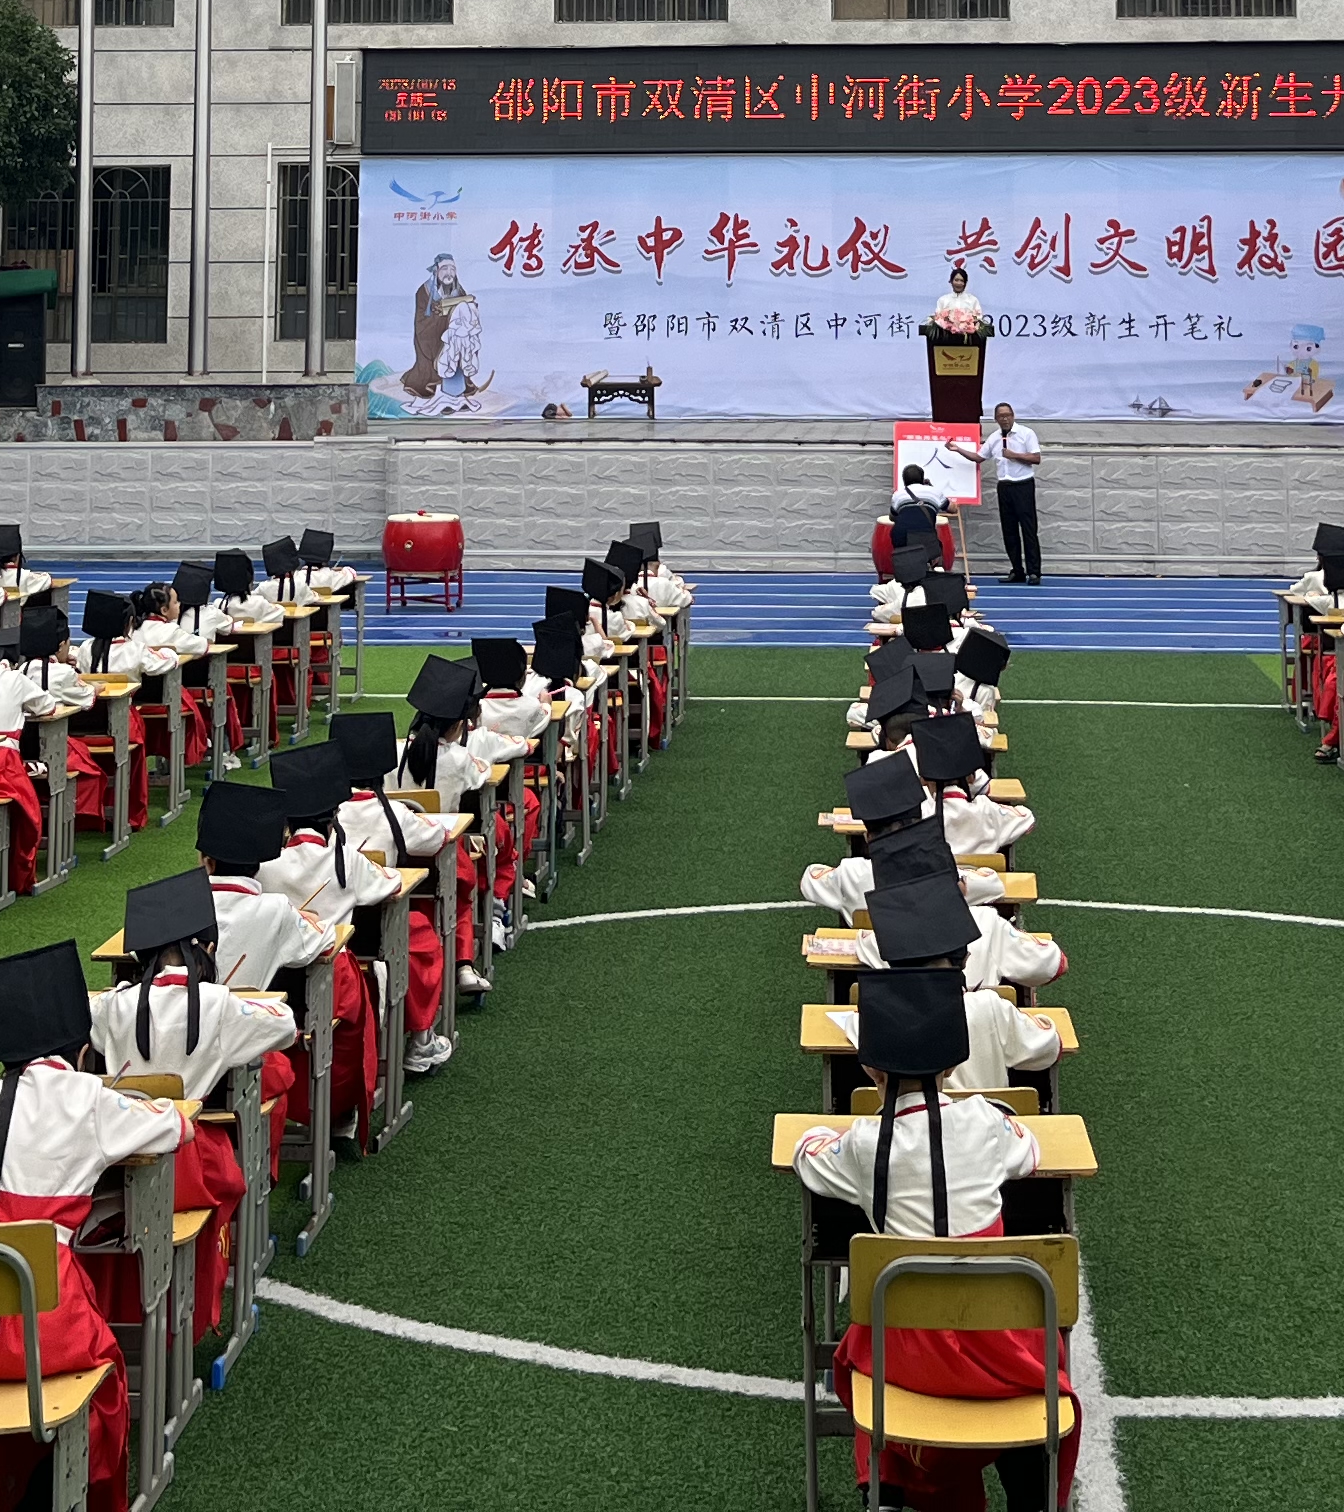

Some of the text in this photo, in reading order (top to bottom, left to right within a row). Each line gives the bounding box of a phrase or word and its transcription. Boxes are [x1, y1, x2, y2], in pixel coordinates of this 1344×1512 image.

[490, 213, 907, 284] 传承中华礼仪
